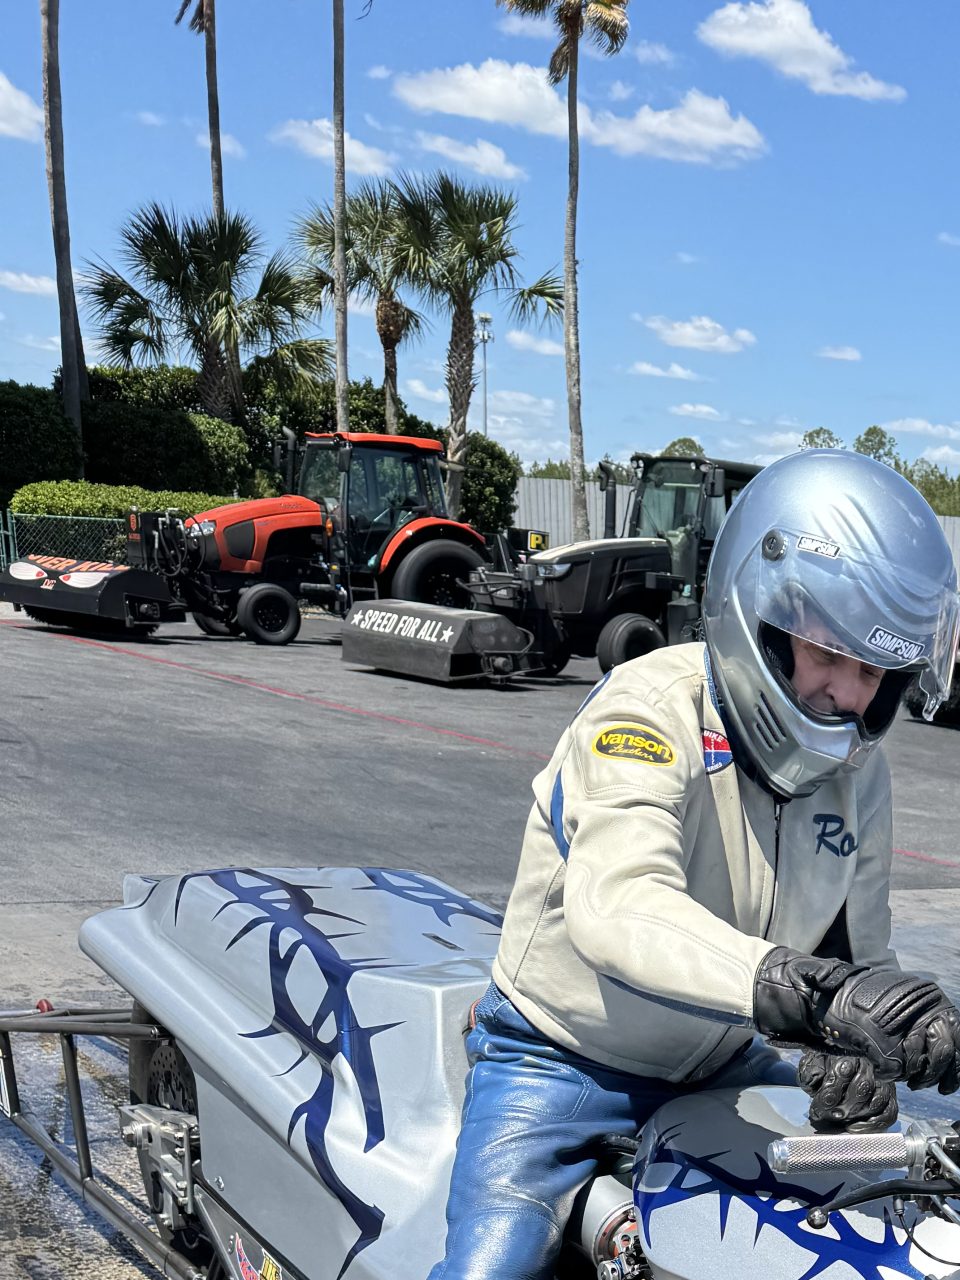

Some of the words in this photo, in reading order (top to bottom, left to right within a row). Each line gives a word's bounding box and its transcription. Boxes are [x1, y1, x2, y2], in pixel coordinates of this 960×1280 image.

[799, 537, 838, 556] SIMPSON
[361, 609, 399, 633] SPEED
[394, 616, 421, 637] FOR
[416, 620, 442, 642] ALL
[871, 630, 921, 659] SIMPSON
[601, 733, 672, 759] vanson
[813, 814, 858, 857] Ro
